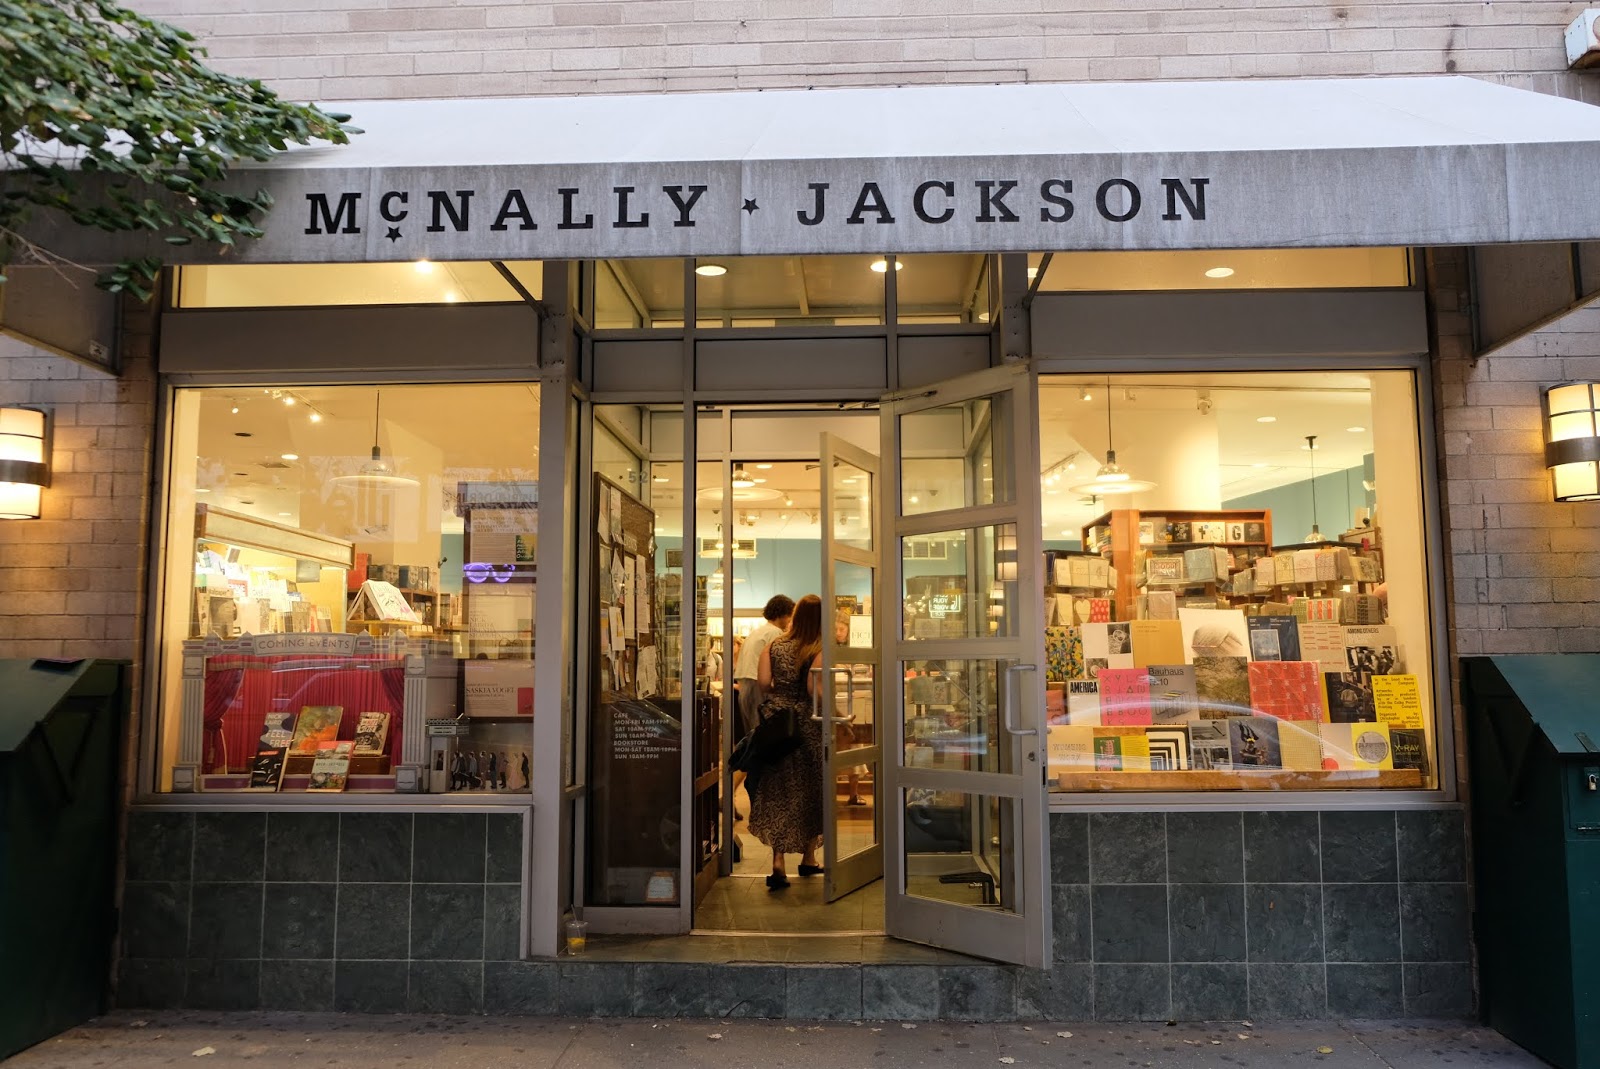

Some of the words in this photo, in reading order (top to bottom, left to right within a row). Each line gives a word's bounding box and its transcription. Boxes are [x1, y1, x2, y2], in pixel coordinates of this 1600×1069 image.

[797, 178, 1210, 226] JACKSON
[628, 471, 649, 484] 52
[258, 638, 304, 650] COMING
[309, 638, 350, 649] EVENTS
[1149, 667, 1184, 675] Bauhaus
[1070, 681, 1098, 693] AMERICA
[265, 730, 286, 738] FEEL
[269, 739, 291, 748] FREE
[1394, 744, 1420, 752] X-RAY
